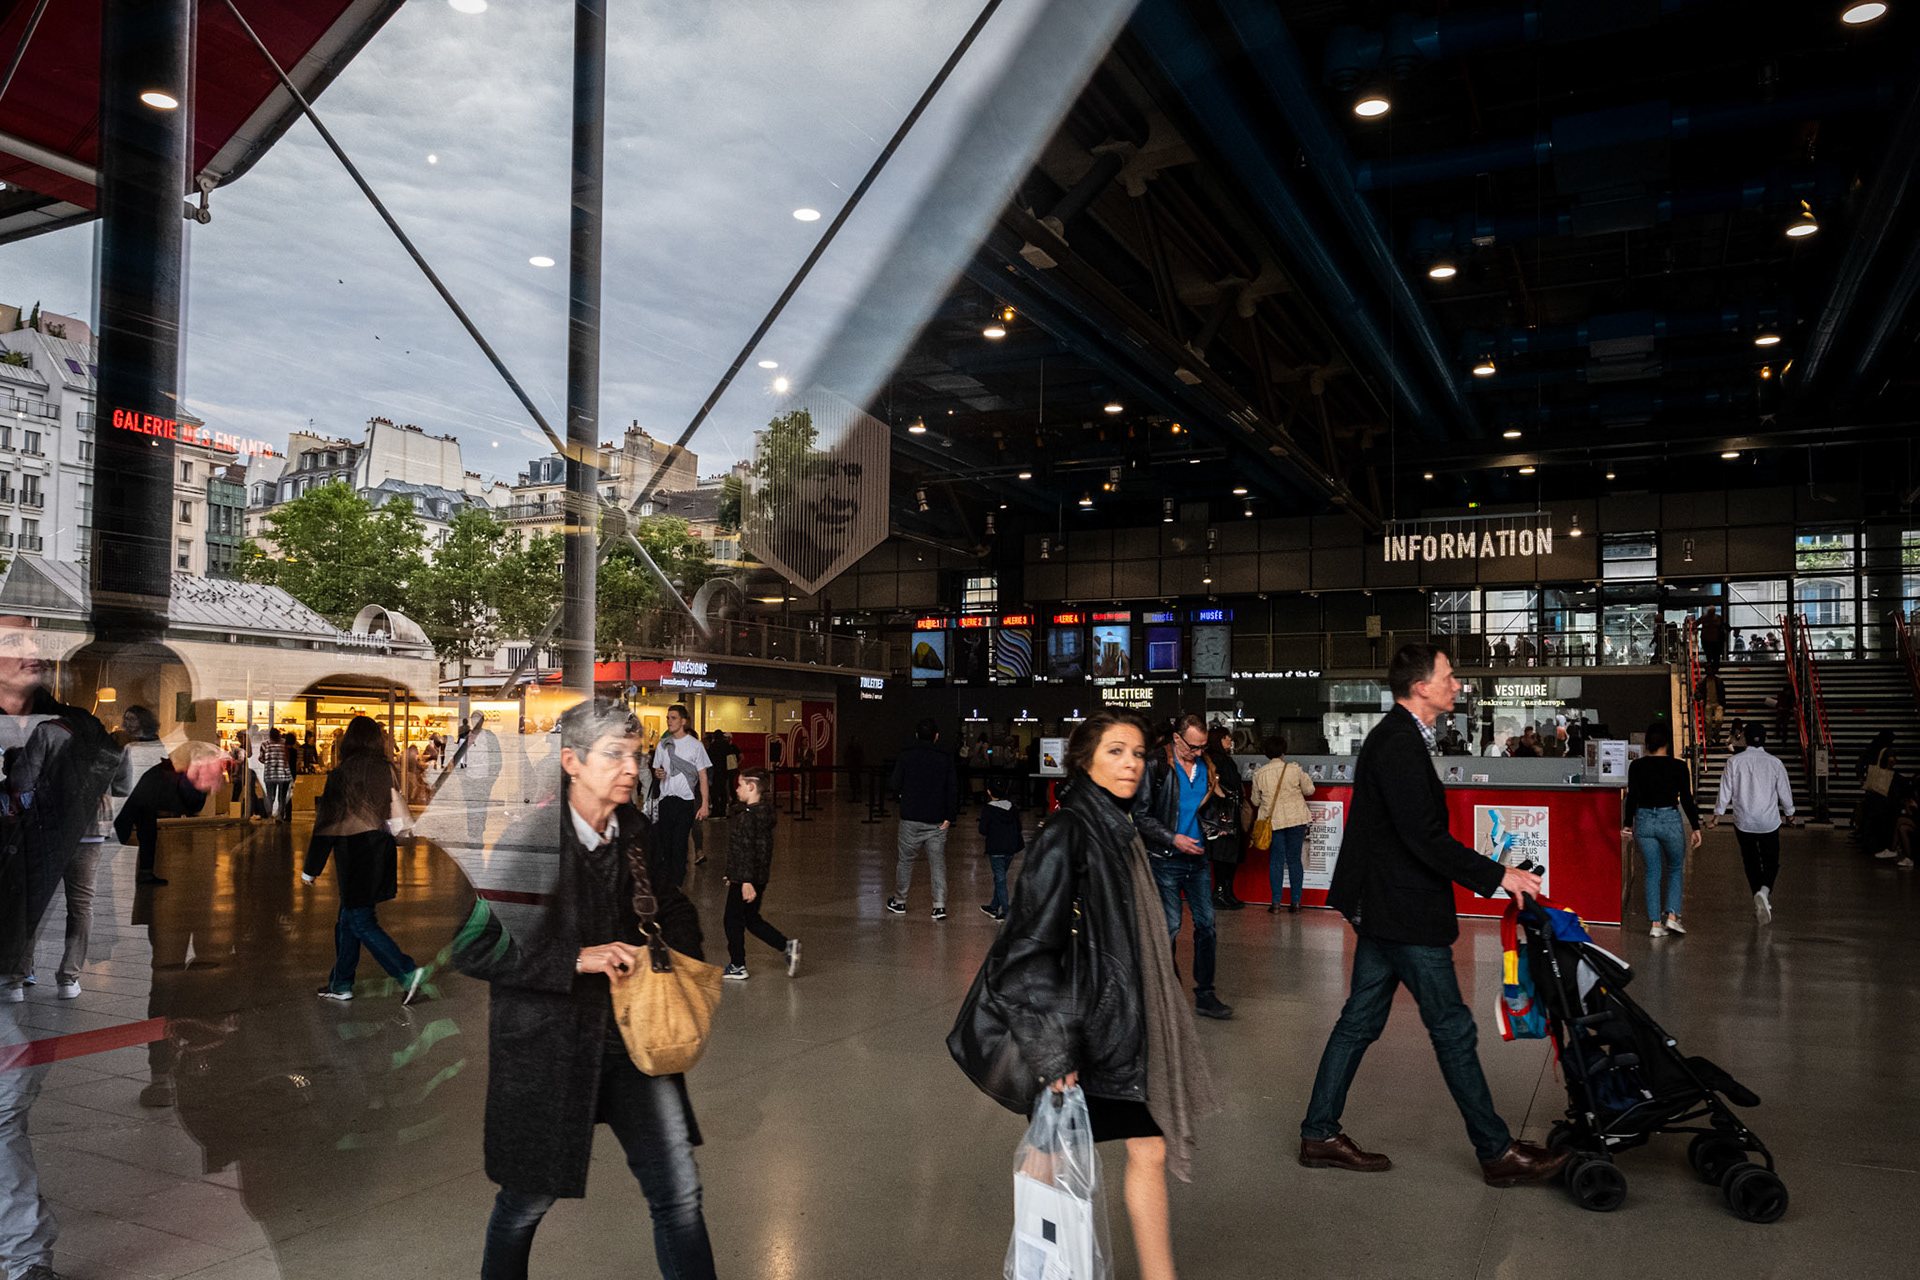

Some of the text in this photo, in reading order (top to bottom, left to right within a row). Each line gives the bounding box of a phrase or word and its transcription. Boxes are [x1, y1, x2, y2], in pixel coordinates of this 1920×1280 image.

[113, 409, 274, 460] GALERIE DES ENFANTS
[1384, 528, 1553, 562] INFORMATION
[1152, 612, 1174, 621] MUSÉE
[1200, 610, 1223, 620] MUSÉE
[671, 658, 708, 675] ADHÉSIONS
[1102, 688, 1153, 699] BILLETTERIE
[1495, 684, 1547, 696] VESTIAIRE
[1478, 698, 1513, 706] cloakroom
[1521, 699, 1566, 707] guardarropa
[973, 709, 977, 717] 1
[1022, 709, 1028, 718] 2
[1073, 709, 1079, 717] 3
[1519, 839, 1547, 848] SE PASSE
